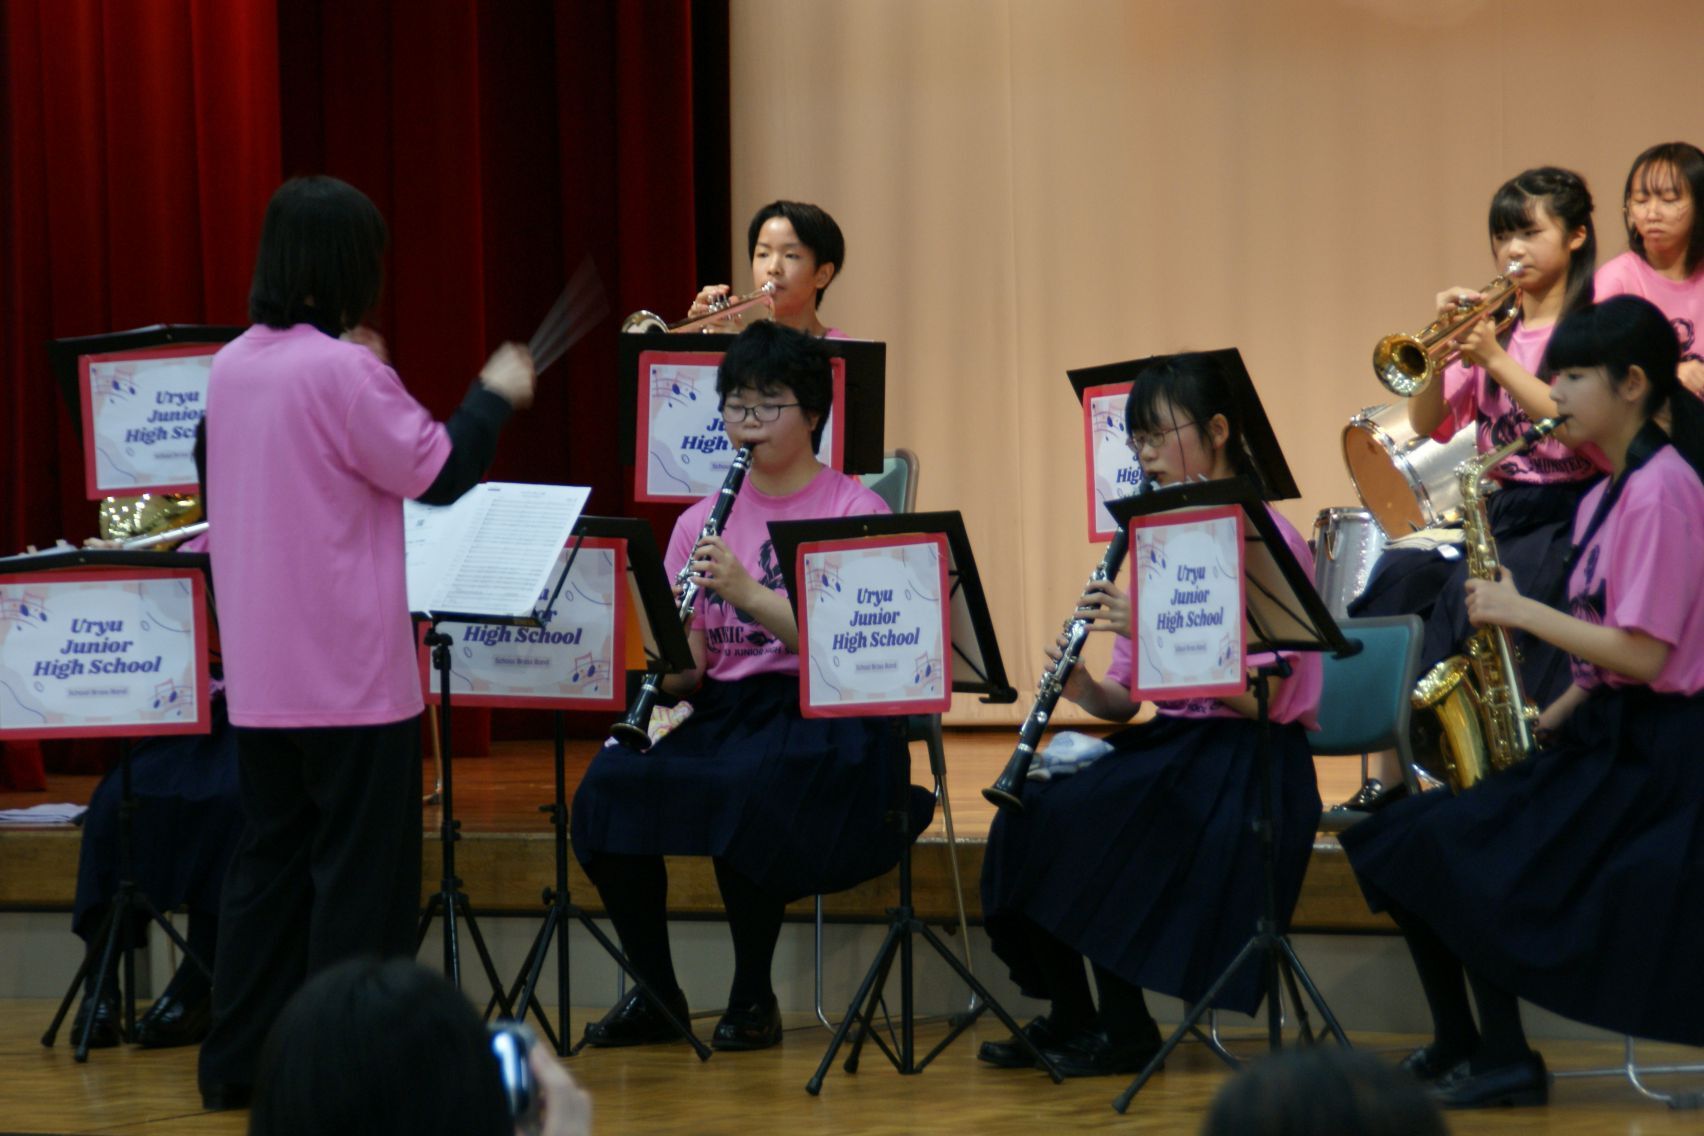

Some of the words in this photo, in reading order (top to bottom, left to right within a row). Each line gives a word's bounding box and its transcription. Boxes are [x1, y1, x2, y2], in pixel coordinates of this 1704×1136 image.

[155, 391, 200, 406] Uryu
[124, 426, 168, 445] High
[681, 434, 729, 454] High
[1177, 564, 1206, 585] Uryu
[857, 588, 893, 607] Uryu
[1170, 585, 1210, 606] Junior
[850, 607, 900, 626] Junior
[1156, 610, 1183, 634] High
[1185, 606, 1224, 628] School
[70, 618, 124, 636] Uryu
[463, 624, 512, 646] High
[514, 626, 583, 645] School
[60, 637, 134, 655] Junior
[832, 631, 867, 653] High
[870, 627, 920, 648] School
[33, 658, 84, 680] High
[88, 656, 162, 674] School
